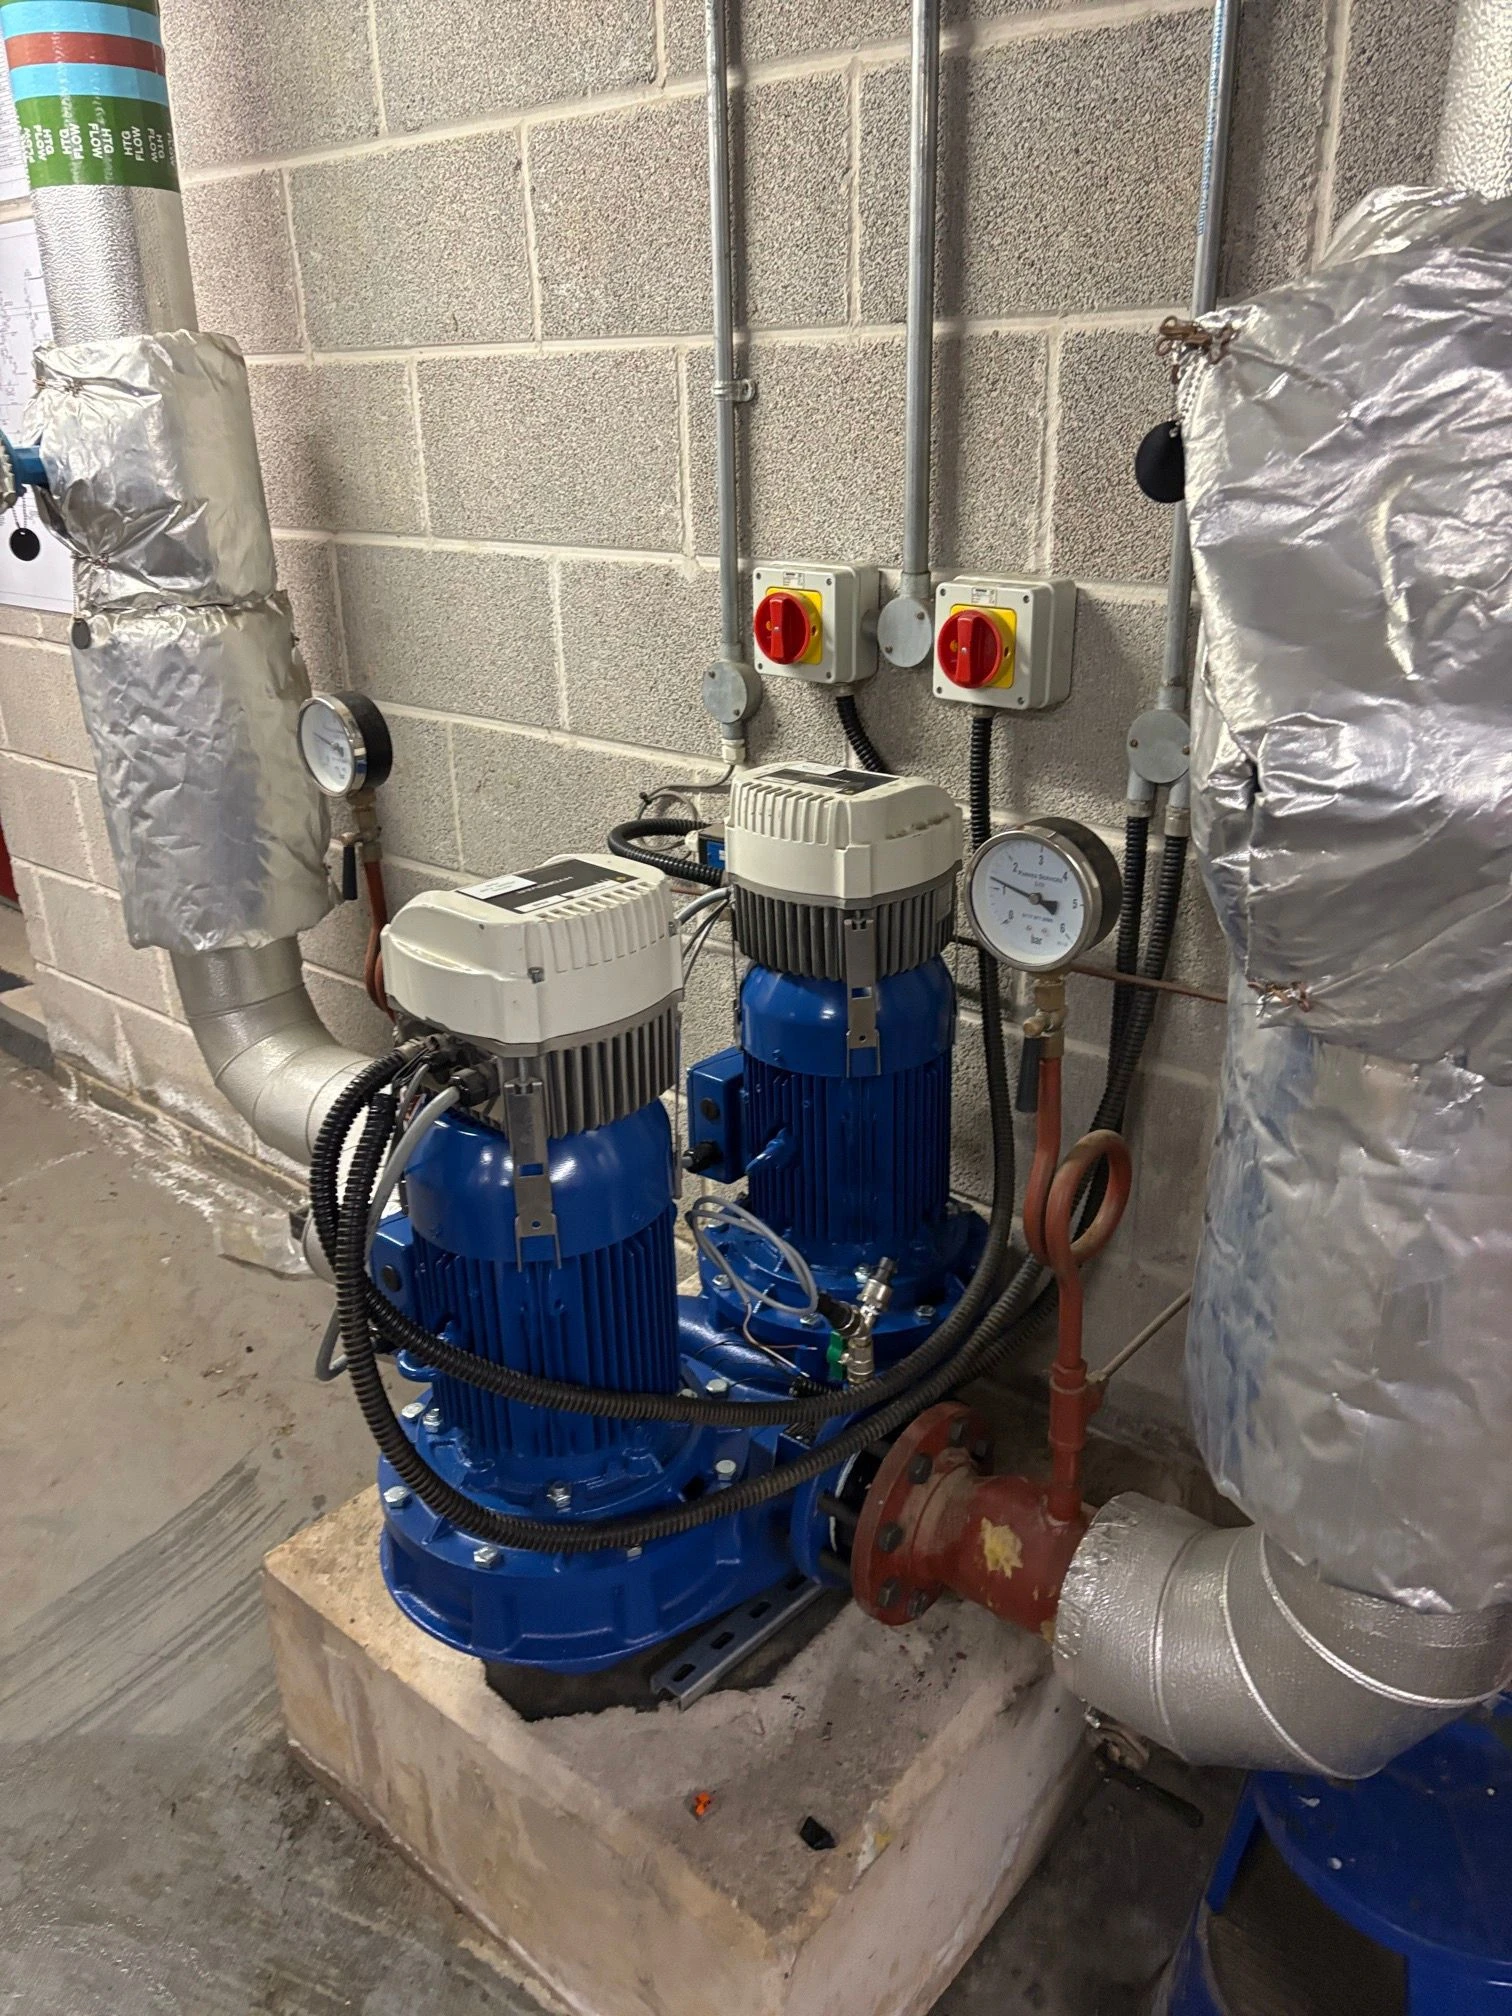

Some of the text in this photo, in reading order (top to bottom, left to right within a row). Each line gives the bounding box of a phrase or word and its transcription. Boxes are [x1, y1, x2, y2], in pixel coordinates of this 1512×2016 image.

[33, 124, 47, 161] FLOW
[42, 128, 55, 156] HTG
[59, 128, 71, 155] HTG
[69, 123, 84, 160] FLOW
[88, 122, 103, 159] FLOW
[101, 127, 115, 154] HTG
[121, 130, 134, 156] HTG
[131, 125, 145, 162] FLOW
[147, 127, 160, 163] FLOW
[156, 134, 166, 159] HTG
[1012, 862, 1019, 873] 2
[1038, 855, 1044, 866] 3
[1062, 871, 1068, 882] 4
[1072, 898, 1078, 909] 5
[1030, 934, 1043, 945] bar
[1060, 923, 1066, 934] 6
